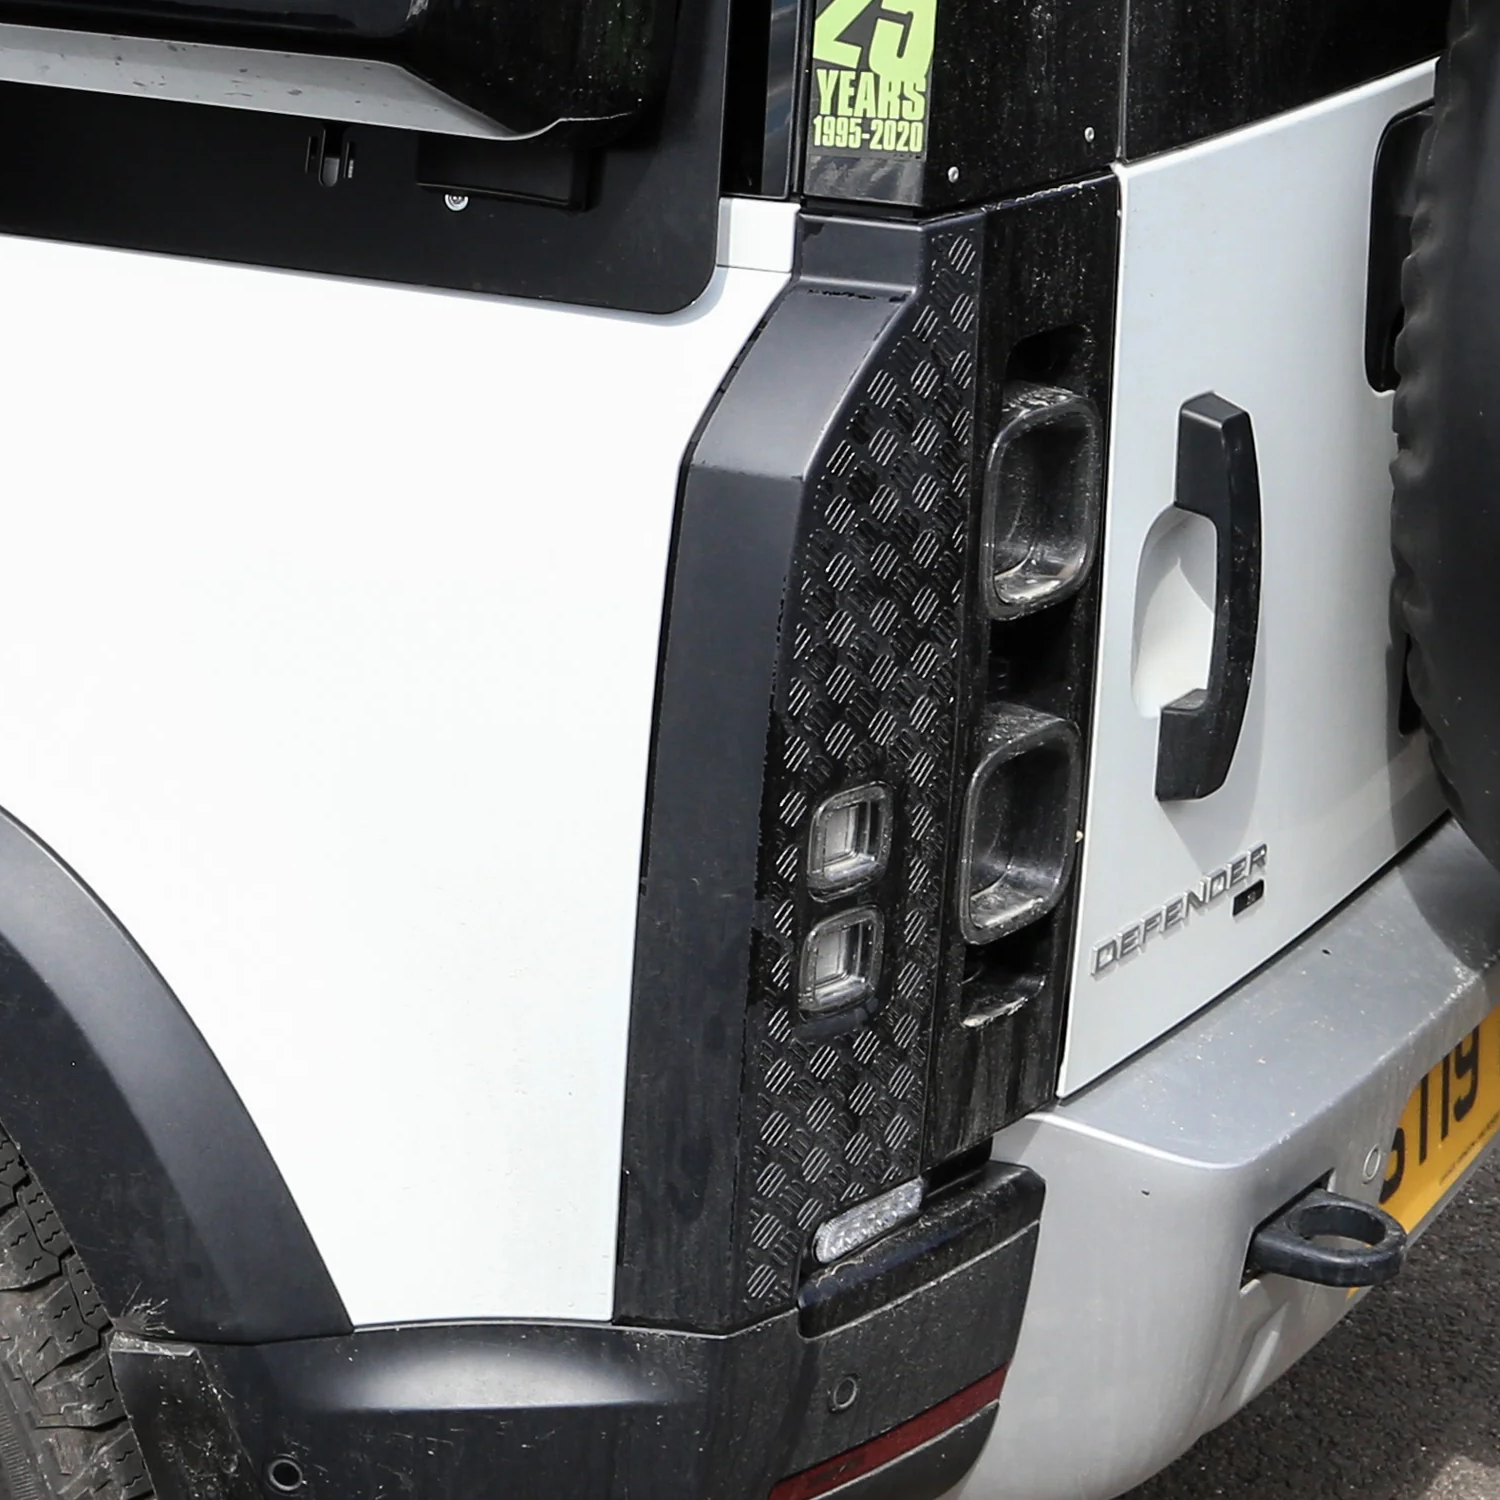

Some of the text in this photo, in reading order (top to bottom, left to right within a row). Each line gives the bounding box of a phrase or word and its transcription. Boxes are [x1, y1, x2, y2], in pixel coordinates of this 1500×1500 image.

[816, 68, 926, 121] YEARS
[813, 115, 924, 152] 1995-2020
[1090, 841, 1268, 977] DEFENDER
